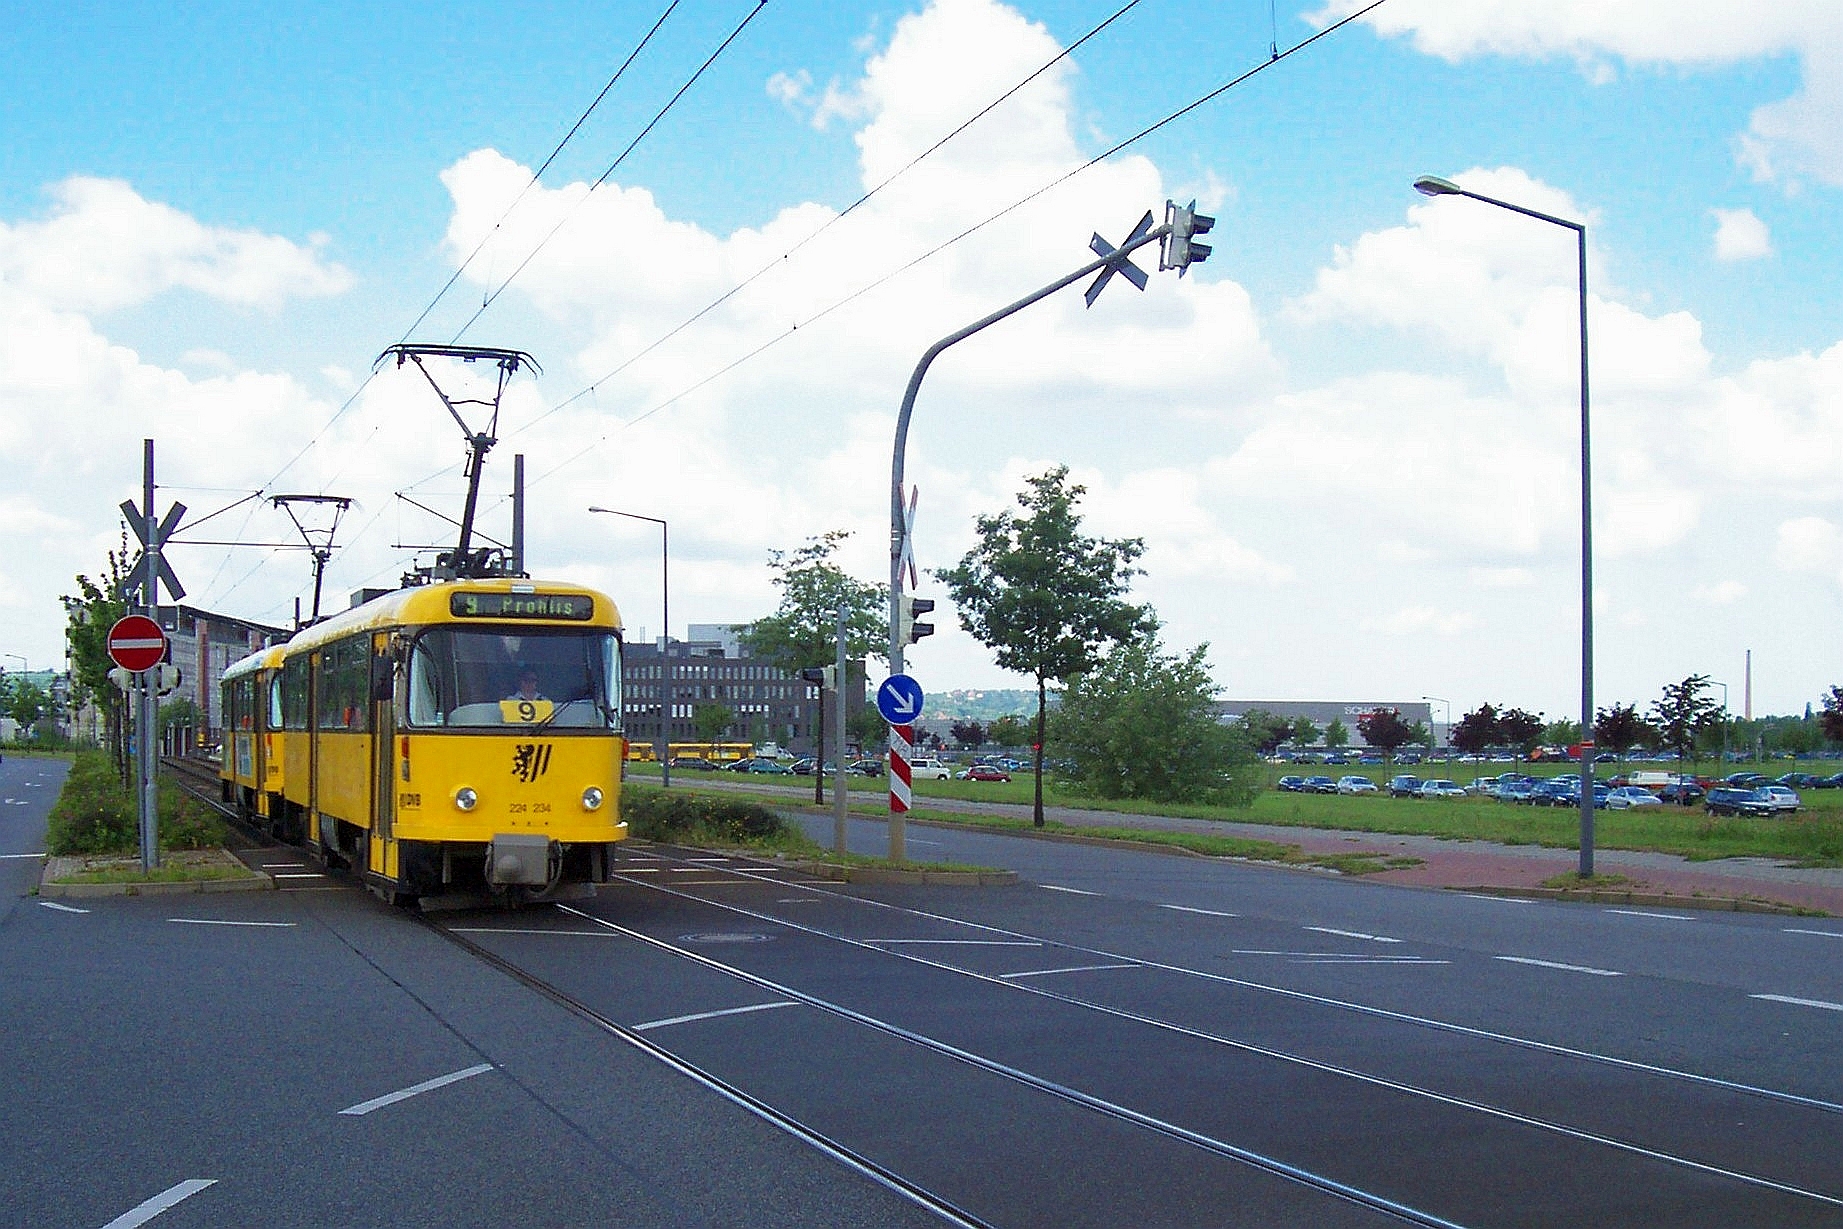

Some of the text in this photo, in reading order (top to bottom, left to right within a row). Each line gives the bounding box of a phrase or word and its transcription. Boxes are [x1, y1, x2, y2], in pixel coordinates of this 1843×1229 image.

[466, 596, 573, 615] 9 Prohlis
[518, 701, 536, 721] 9
